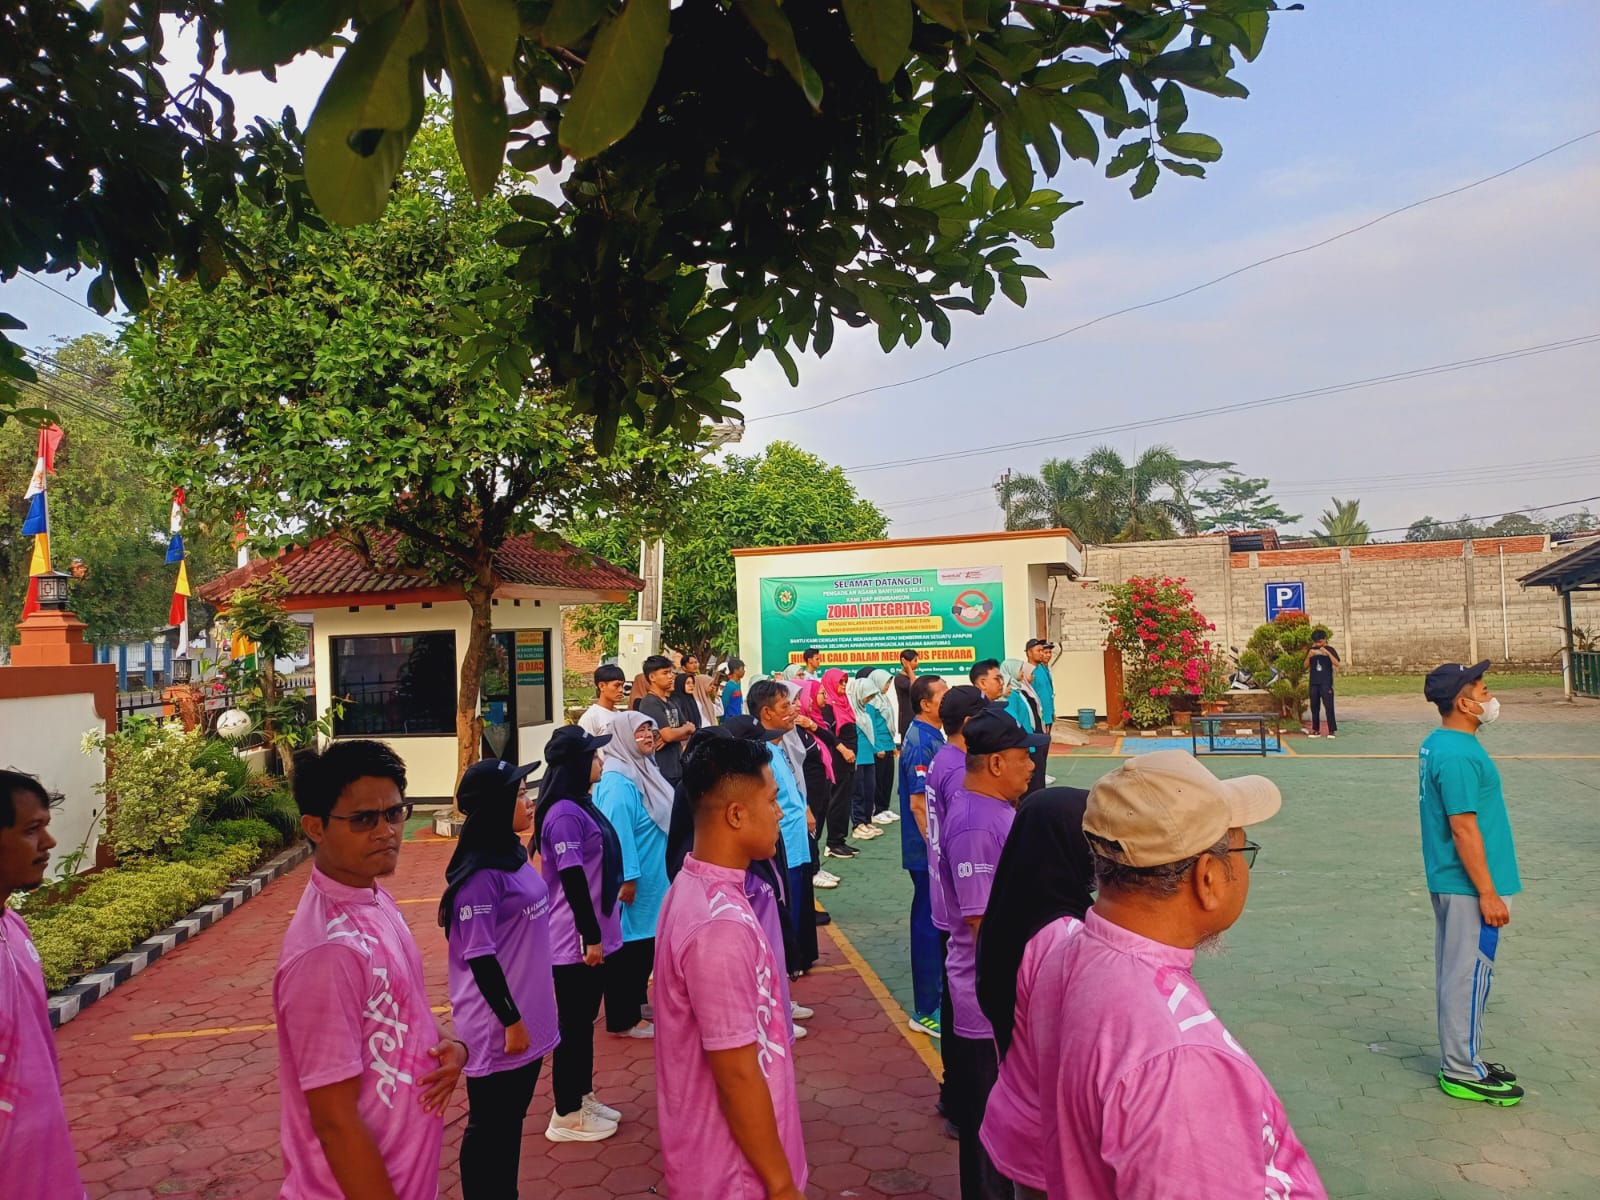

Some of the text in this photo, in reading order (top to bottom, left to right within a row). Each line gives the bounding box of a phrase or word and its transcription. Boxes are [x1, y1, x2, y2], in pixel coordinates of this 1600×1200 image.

[834, 579, 873, 588] SELAMAT
[875, 578, 911, 586] DATANG
[1276, 588, 1293, 607] P
[827, 601, 931, 618] ZONA INTEGRITAS
[827, 652, 848, 662] CALO
[850, 652, 880, 662] DALAM
[932, 649, 973, 660] PERKARA
